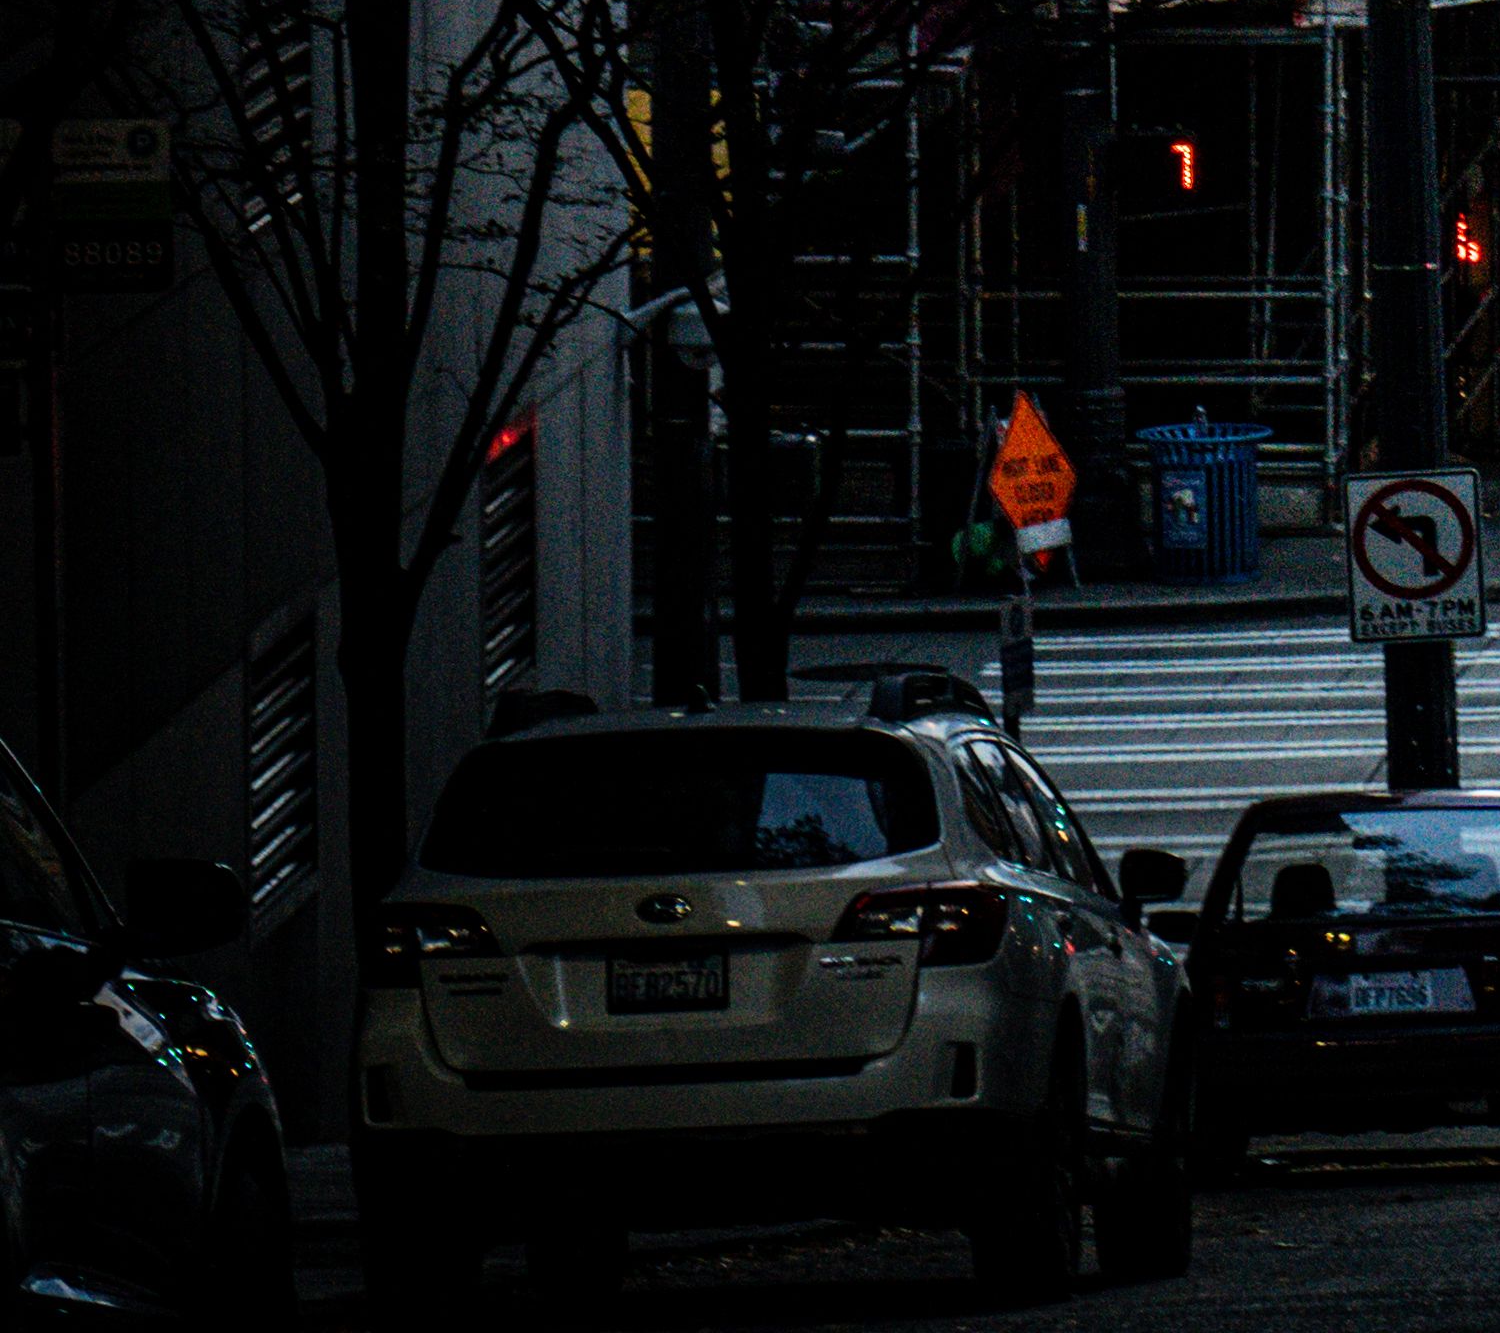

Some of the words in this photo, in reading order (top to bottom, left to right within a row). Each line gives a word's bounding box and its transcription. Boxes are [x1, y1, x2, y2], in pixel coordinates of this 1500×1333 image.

[63, 241, 163, 266] 88089
[1361, 620, 1420, 636] EXCEPT
[1427, 618, 1476, 633] BUSES
